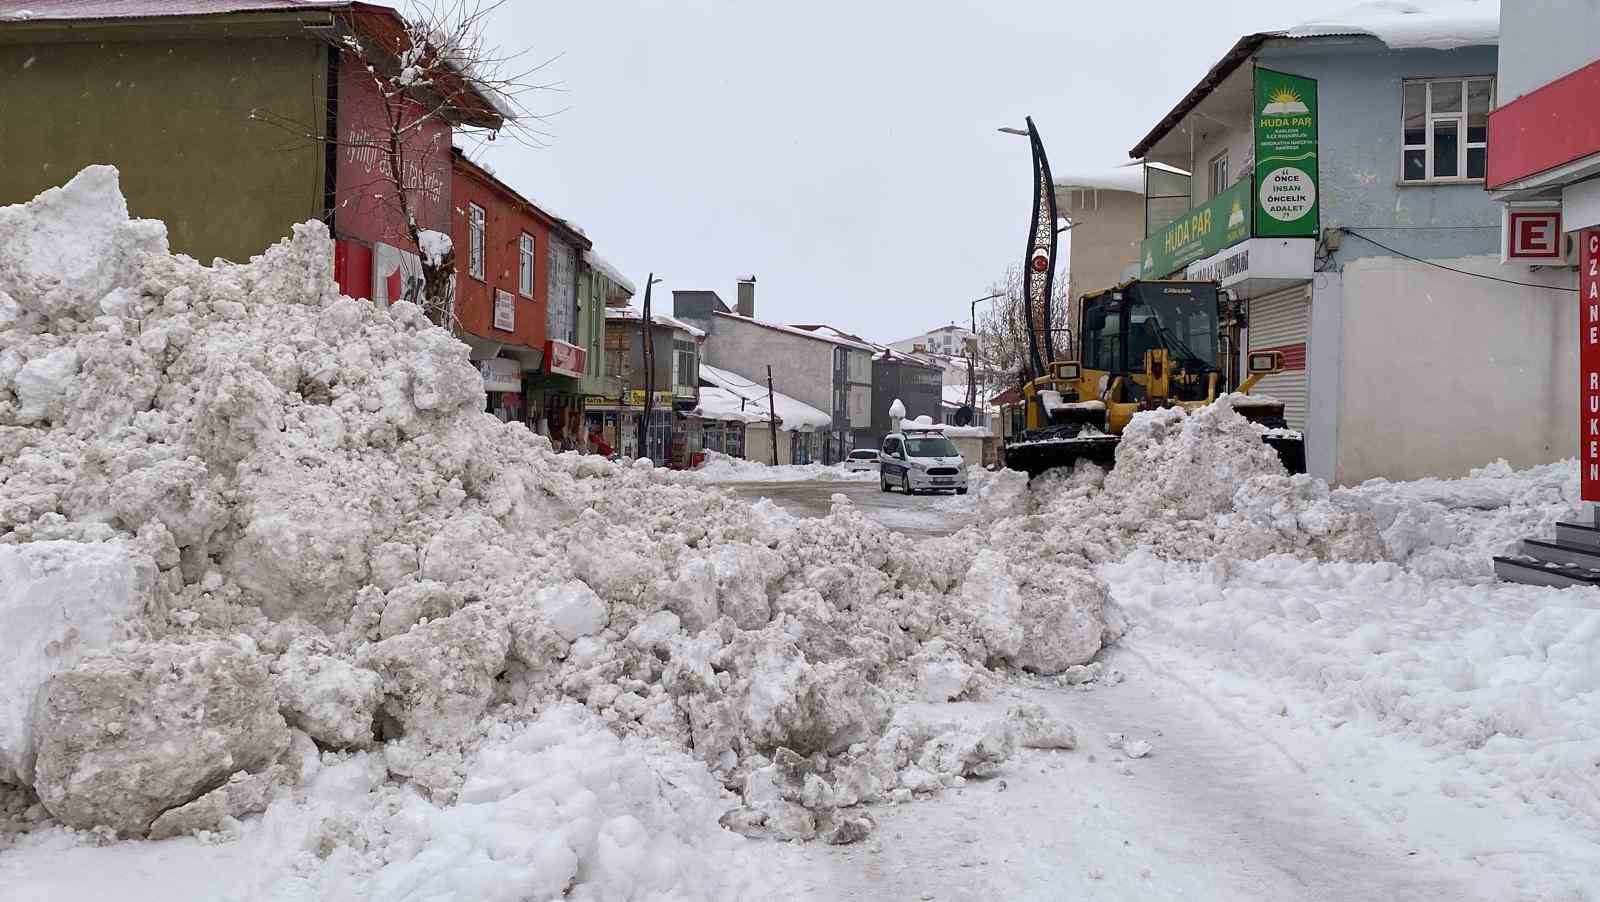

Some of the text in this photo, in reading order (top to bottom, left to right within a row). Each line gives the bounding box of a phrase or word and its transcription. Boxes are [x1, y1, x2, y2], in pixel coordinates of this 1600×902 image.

[1291, 117, 1312, 127] PAR
[1274, 174, 1300, 182] ÖNCE
[1267, 195, 1306, 203] ÖNCELİK
[1191, 207, 1212, 240] PAR
[1521, 220, 1548, 250] E
[1590, 371, 1599, 481] RUKEN
